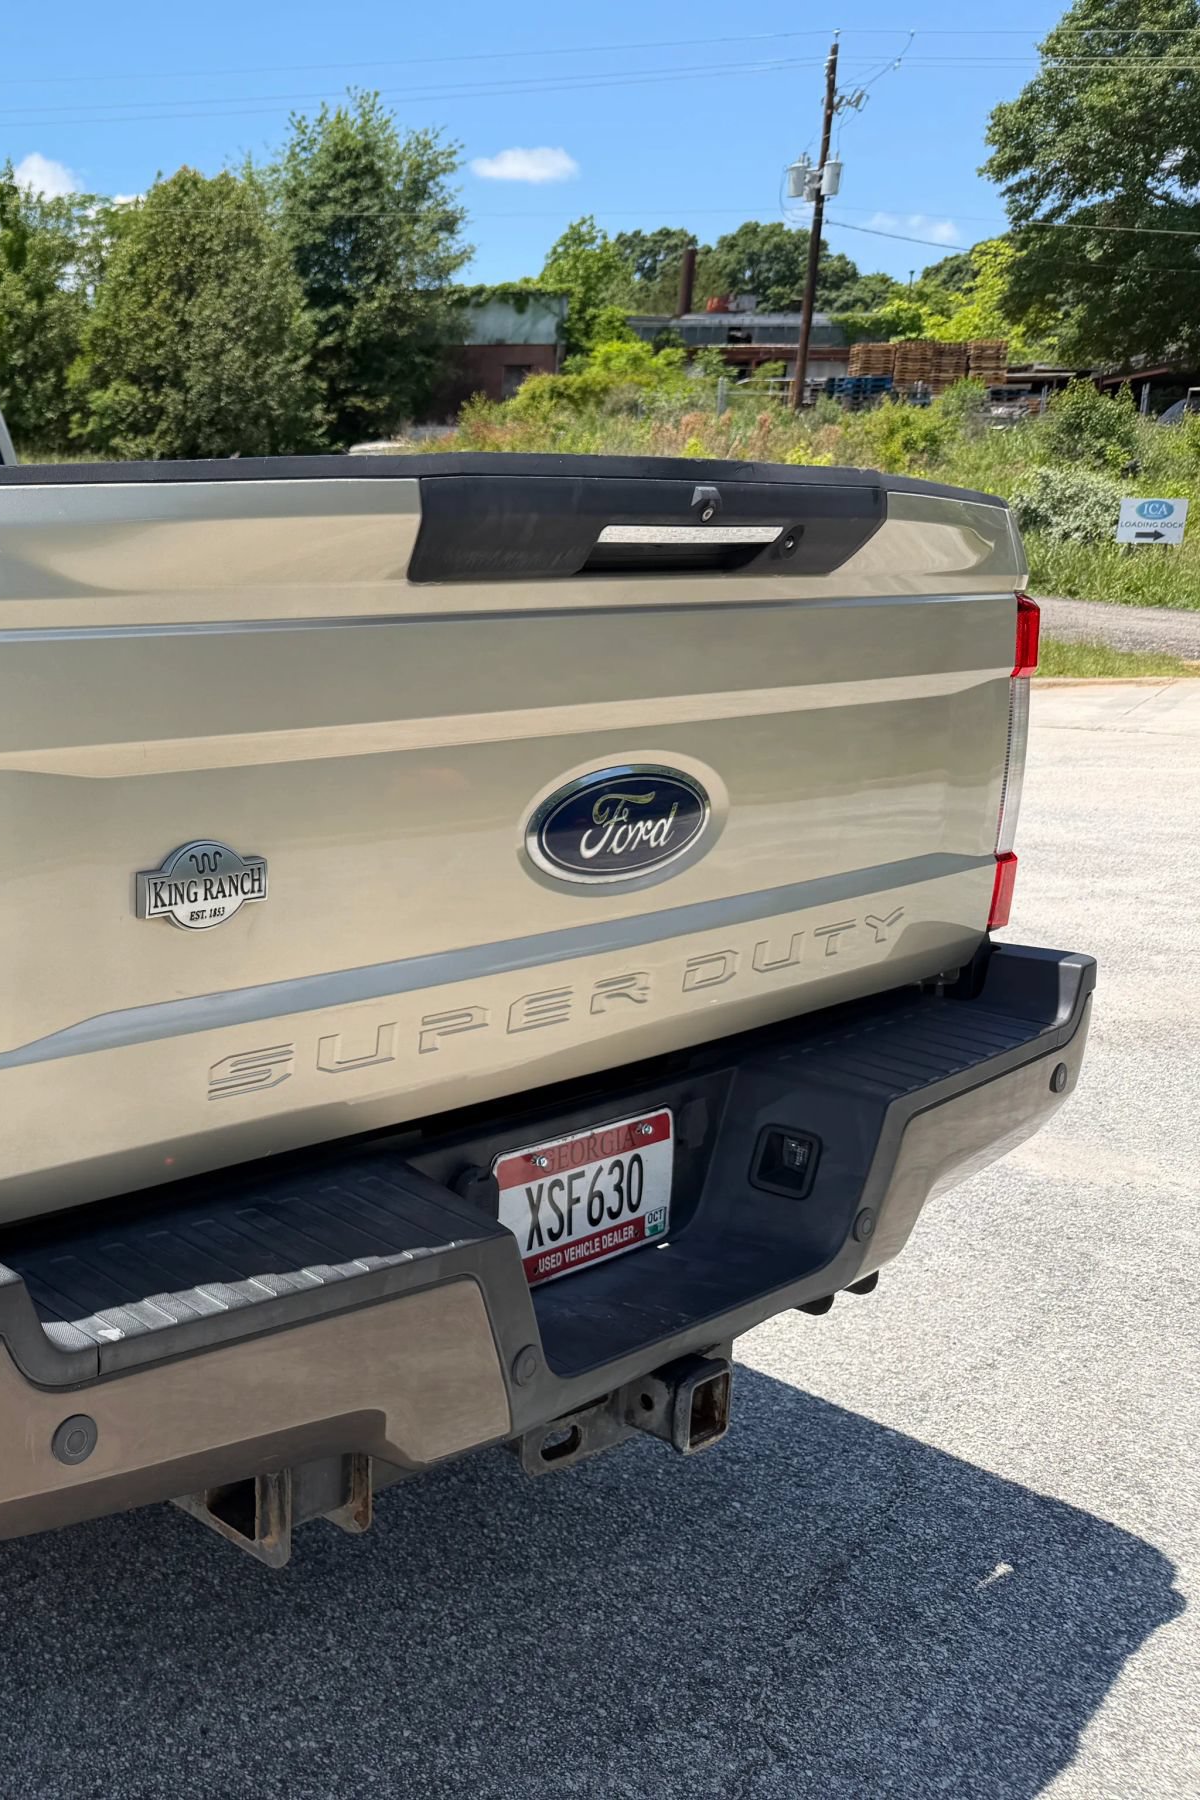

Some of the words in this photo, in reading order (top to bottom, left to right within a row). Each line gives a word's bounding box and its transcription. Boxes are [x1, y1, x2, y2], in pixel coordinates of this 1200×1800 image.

[1120, 521, 1158, 529] LOADING
[1160, 521, 1184, 529] DOCK
[1143, 503, 1168, 515] ICA
[580, 790, 679, 859] Ford
[153, 880, 199, 909] KING
[203, 867, 264, 901] RANCH
[189, 909, 207, 921] EST.
[209, 906, 226, 919] 1853
[208, 971, 652, 1101] SUPER
[681, 906, 905, 992] DUTY
[542, 1126, 637, 1174] GEORGIA
[525, 1153, 644, 1251] XSF630
[647, 1208, 664, 1224] OCT
[538, 1254, 563, 1273] USED
[563, 1238, 601, 1266] VEHICLE
[602, 1225, 635, 1249] DEALER
